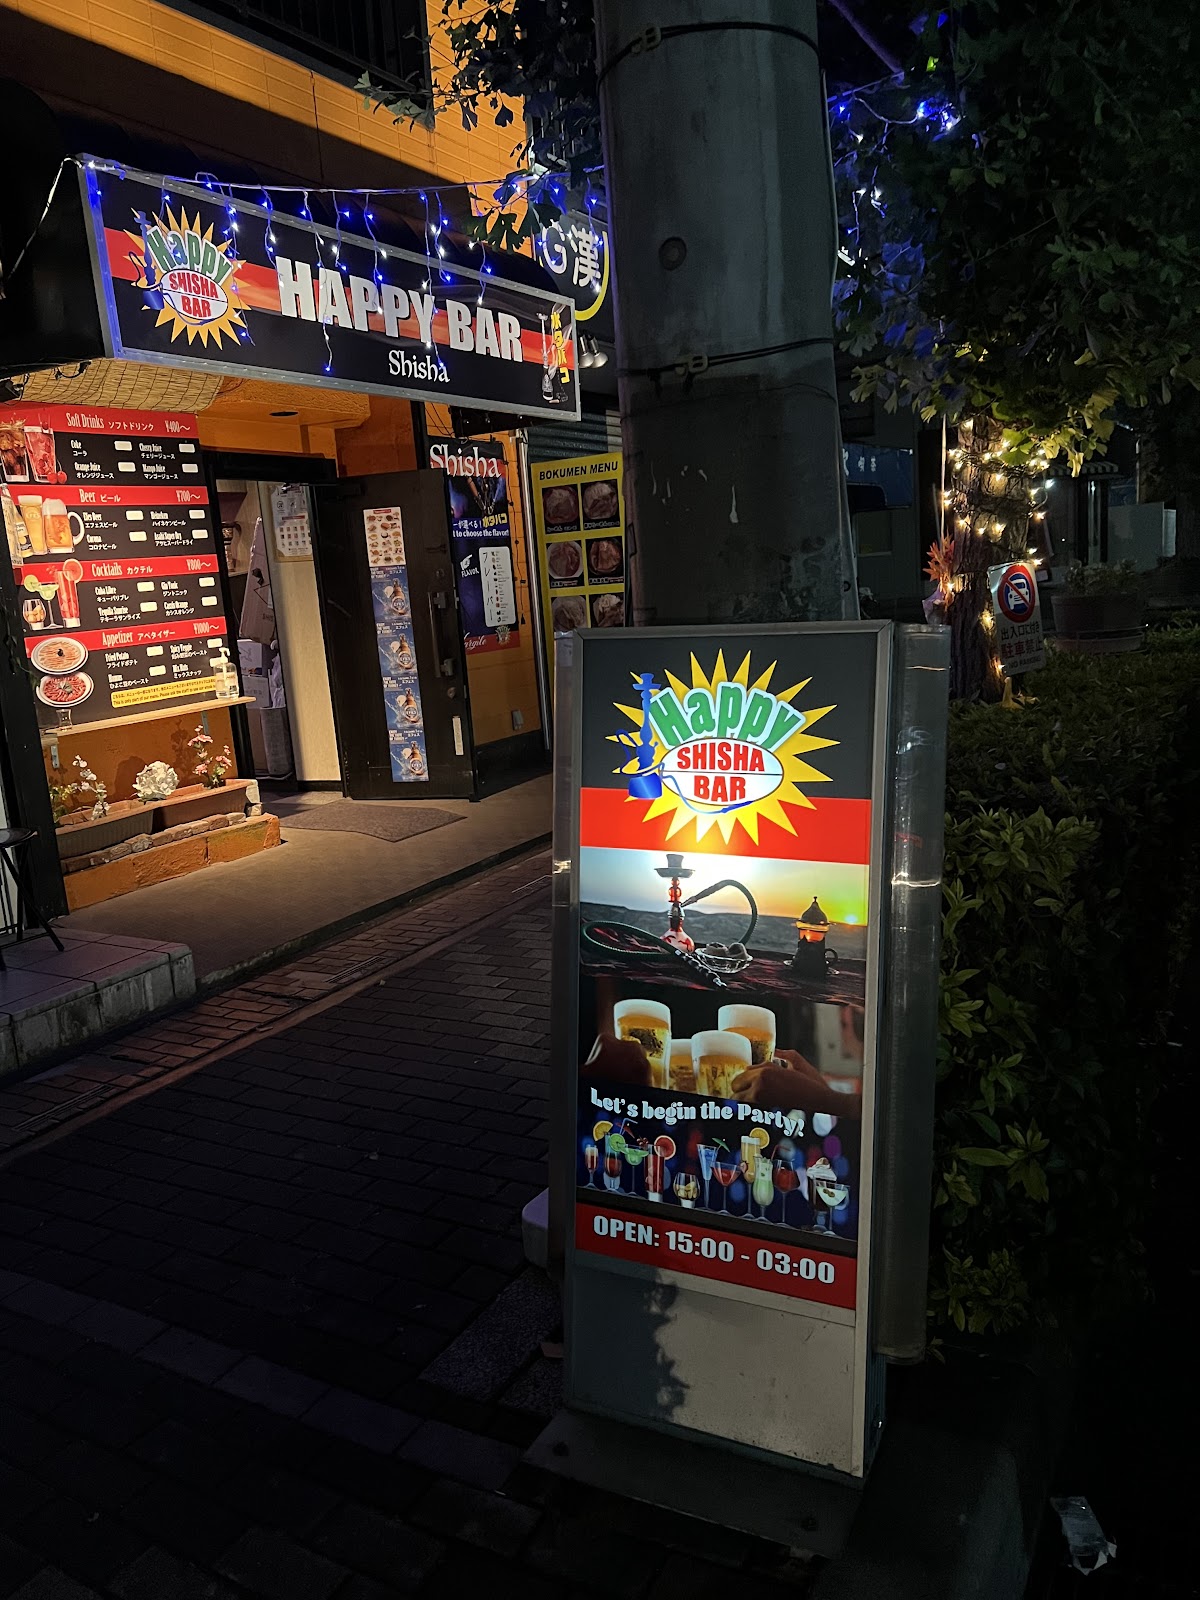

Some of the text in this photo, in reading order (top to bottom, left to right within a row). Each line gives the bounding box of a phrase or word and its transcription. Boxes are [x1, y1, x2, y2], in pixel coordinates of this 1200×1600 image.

[147, 226, 233, 285] Happy
[168, 272, 219, 299] SHISHA
[181, 296, 212, 318] BAR
[275, 256, 524, 363] HAPPY BAR
[550, 311, 571, 384] 水タバコ
[388, 349, 451, 384] Shisha
[66, 412, 81, 428] Soft
[81, 413, 105, 429] Drinks
[108, 421, 154, 432] ソフトドリンク
[430, 443, 502, 479] Shisha
[539, 461, 619, 481] BOKUMEN MENU
[79, 488, 96, 503] Beer
[100, 494, 122, 503] ビール
[463, 528, 482, 538] choose
[91, 562, 123, 578] Cocktails
[126, 565, 153, 576] カクテル
[102, 630, 133, 647] Appetizer
[650, 683, 804, 749] Happy
[677, 741, 765, 773] SHISHA
[693, 775, 747, 803] BAR
[590, 1086, 805, 1137] Let's begin the Party!
[593, 1215, 660, 1248] OPEN:
[665, 1230, 735, 1264] 15:00
[756, 1248, 835, 1285] 03:00
